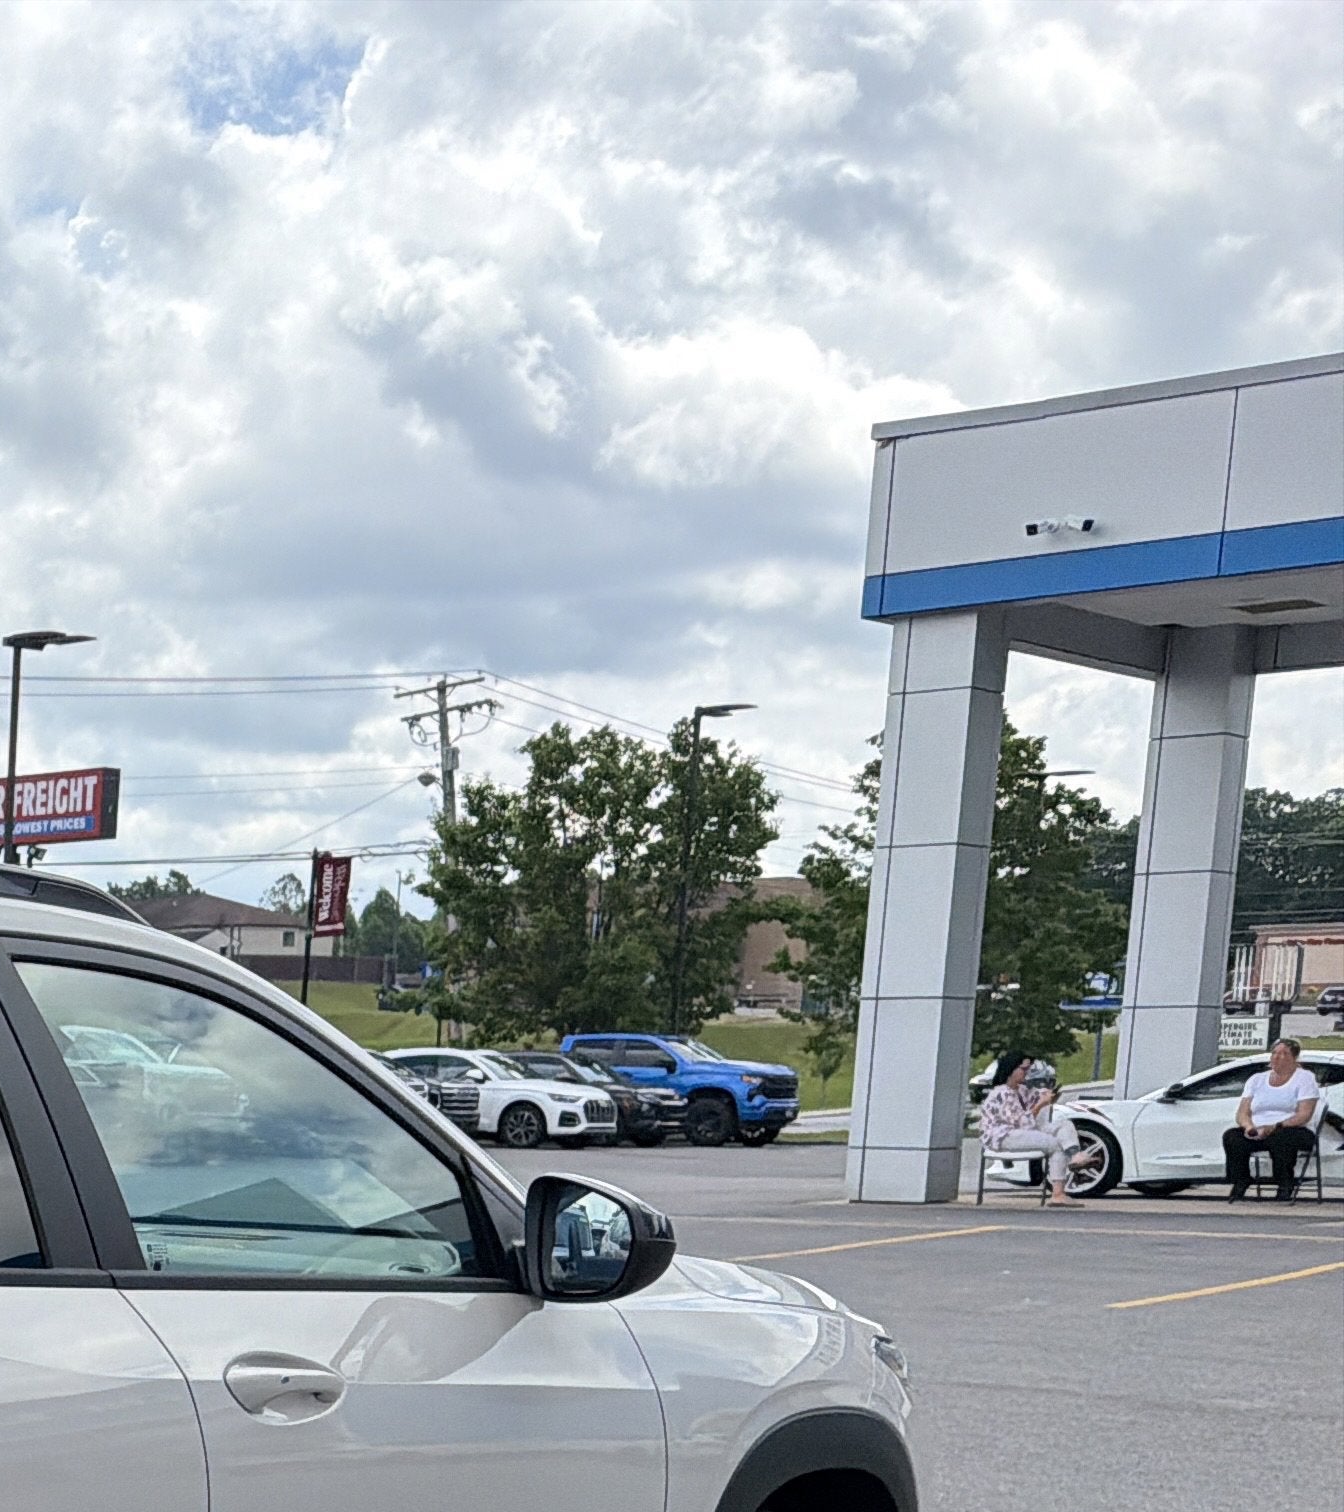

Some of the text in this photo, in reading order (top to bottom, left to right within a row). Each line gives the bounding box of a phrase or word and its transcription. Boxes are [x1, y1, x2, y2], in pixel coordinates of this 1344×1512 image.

[13, 775, 98, 817] FREIGHT
[14, 818, 49, 834] OWEST
[50, 817, 86, 831] PRICES
[318, 863, 334, 922] Welcome
